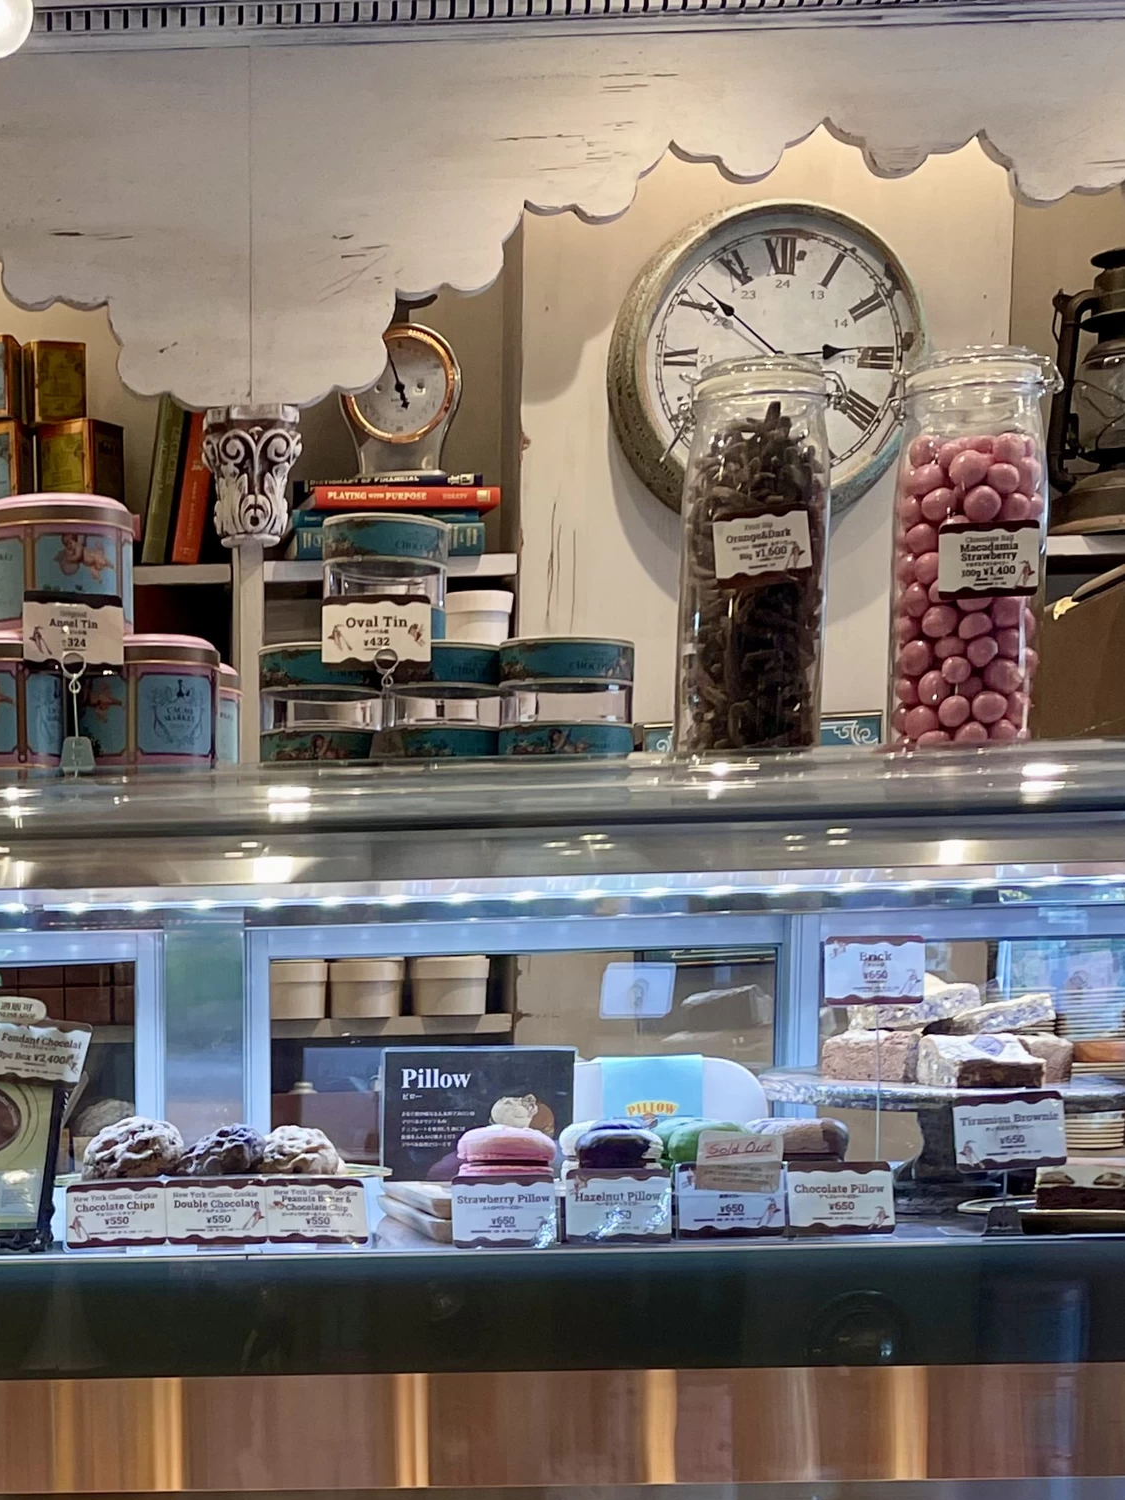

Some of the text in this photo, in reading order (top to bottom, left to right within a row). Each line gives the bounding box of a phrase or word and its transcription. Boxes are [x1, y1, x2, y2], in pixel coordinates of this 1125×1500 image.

[775, 279, 791, 289] 24
[741, 290, 756, 300] 23
[810, 290, 825, 300] 13
[713, 317, 728, 327] 22
[834, 318, 849, 329] 14
[700, 354, 714, 364] 21
[841, 355, 856, 365] 15
[327, 491, 367, 500] PLAYING
[385, 491, 428, 500] PURPOSE
[725, 527, 792, 545] Orange&Dark
[960, 541, 1019, 553] Macadamia
[960, 551, 1017, 564] Strawberry
[961, 565, 1016, 579] 100g ¥1,400
[81, 619, 99, 630] Tin
[346, 615, 408, 629] Oval Tin
[364, 637, 391, 647] ¥432
[1, 1032, 82, 1051] Fondant Chocolat
[400, 1068, 472, 1089] Pillow
[627, 1101, 679, 1116] PILLOW
[1012, 1111, 1060, 1124] Brownie
[999, 1135, 1026, 1145] ¥650
[708, 1141, 773, 1155] Sold Out
[794, 1183, 885, 1194] Chocolate Pillow
[281, 1195, 316, 1203] Peanuts
[318, 1195, 343, 1203] Bter
[456, 1193, 551, 1206] Strawberry Pillow
[575, 1190, 661, 1203] Hazelnut Pillow
[74, 1201, 156, 1214] Chocolate Chips
[173, 1198, 260, 1210] Double Chocolate
[719, 1203, 745, 1214] ¥650
[828, 1201, 855, 1212] ¥650
[104, 1215, 130, 1226] ¥550
[206, 1214, 232, 1225] ¥550
